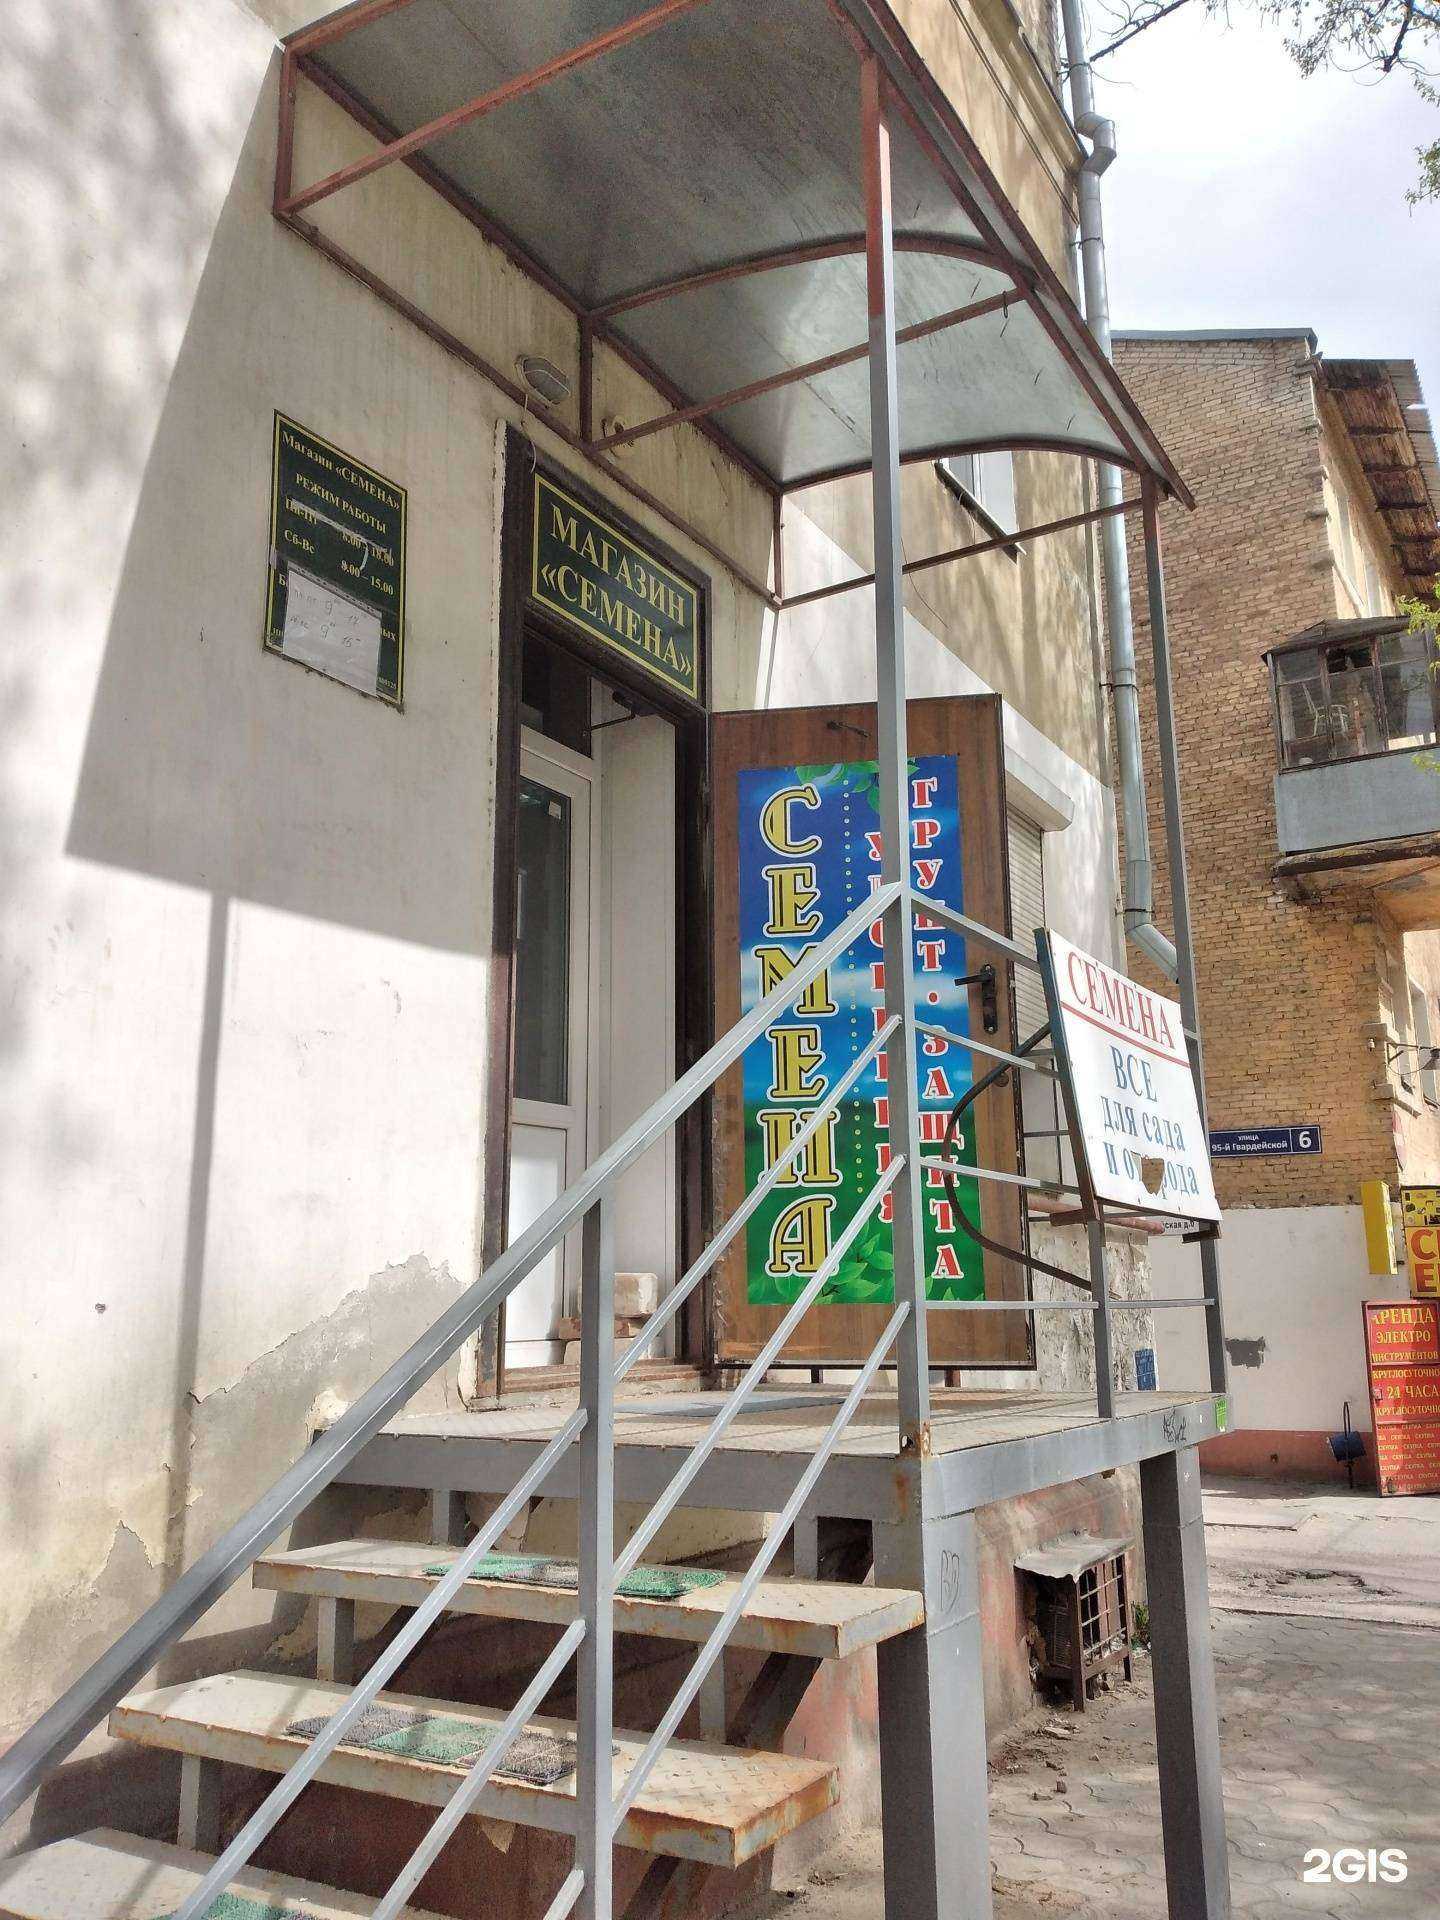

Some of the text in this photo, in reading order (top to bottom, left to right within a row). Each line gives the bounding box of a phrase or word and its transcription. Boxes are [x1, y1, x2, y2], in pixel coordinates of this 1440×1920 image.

[282, 430, 400, 512] Магазин «СЕМЕНА»
[296, 472, 387, 535] РЕЖИМ РАБОТЫ
[371, 575, 394, 596] 15.00
[551, 502, 686, 628] МАГАЗИН
[540, 562, 692, 677] «СЕМЕНА»
[911, 777, 946, 972] ГРУТ
[1067, 951, 1176, 1050] СЕМЕНА
[754, 785, 841, 1277] СЕМЕНА
[1110, 1045, 1158, 1103] ВСЕ
[1142, 1112, 1186, 1152] сада
[1211, 1140, 1288, 1152] 95-й Гвардейской
[1299, 1130, 1312, 1149] 6
[1371, 1350, 1439, 1363] ИНСТРУМЕНТОВ
[1376, 1330, 1432, 1344] ЭЛЕКТРО
[1387, 1384, 1440, 1399] 24 ЧАСА
